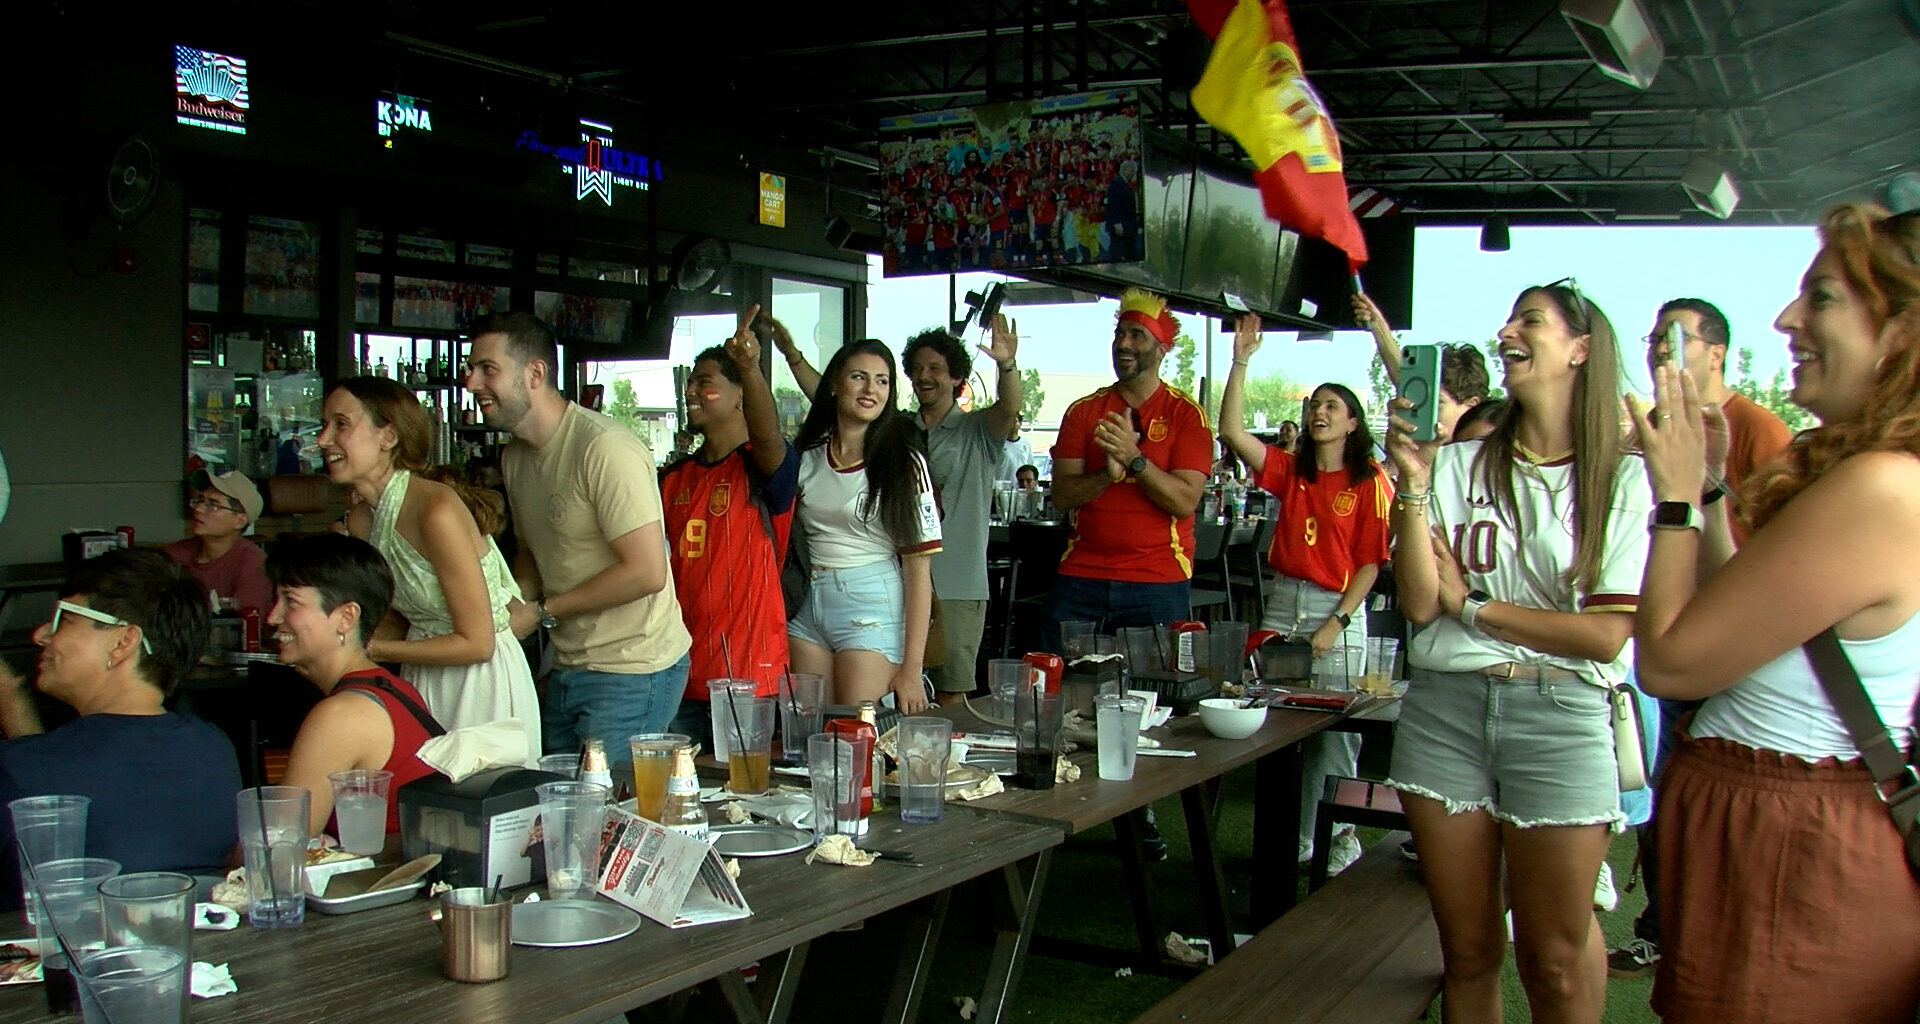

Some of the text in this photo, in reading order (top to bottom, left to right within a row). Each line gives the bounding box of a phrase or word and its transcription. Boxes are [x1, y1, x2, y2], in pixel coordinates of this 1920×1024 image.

[177, 97, 245, 123] Budweiser
[378, 100, 432, 131] KONA
[760, 190, 784, 201] MANGO
[764, 199, 780, 209] CART
[1305, 517, 1317, 547] 9
[1452, 521, 1499, 575] 10
